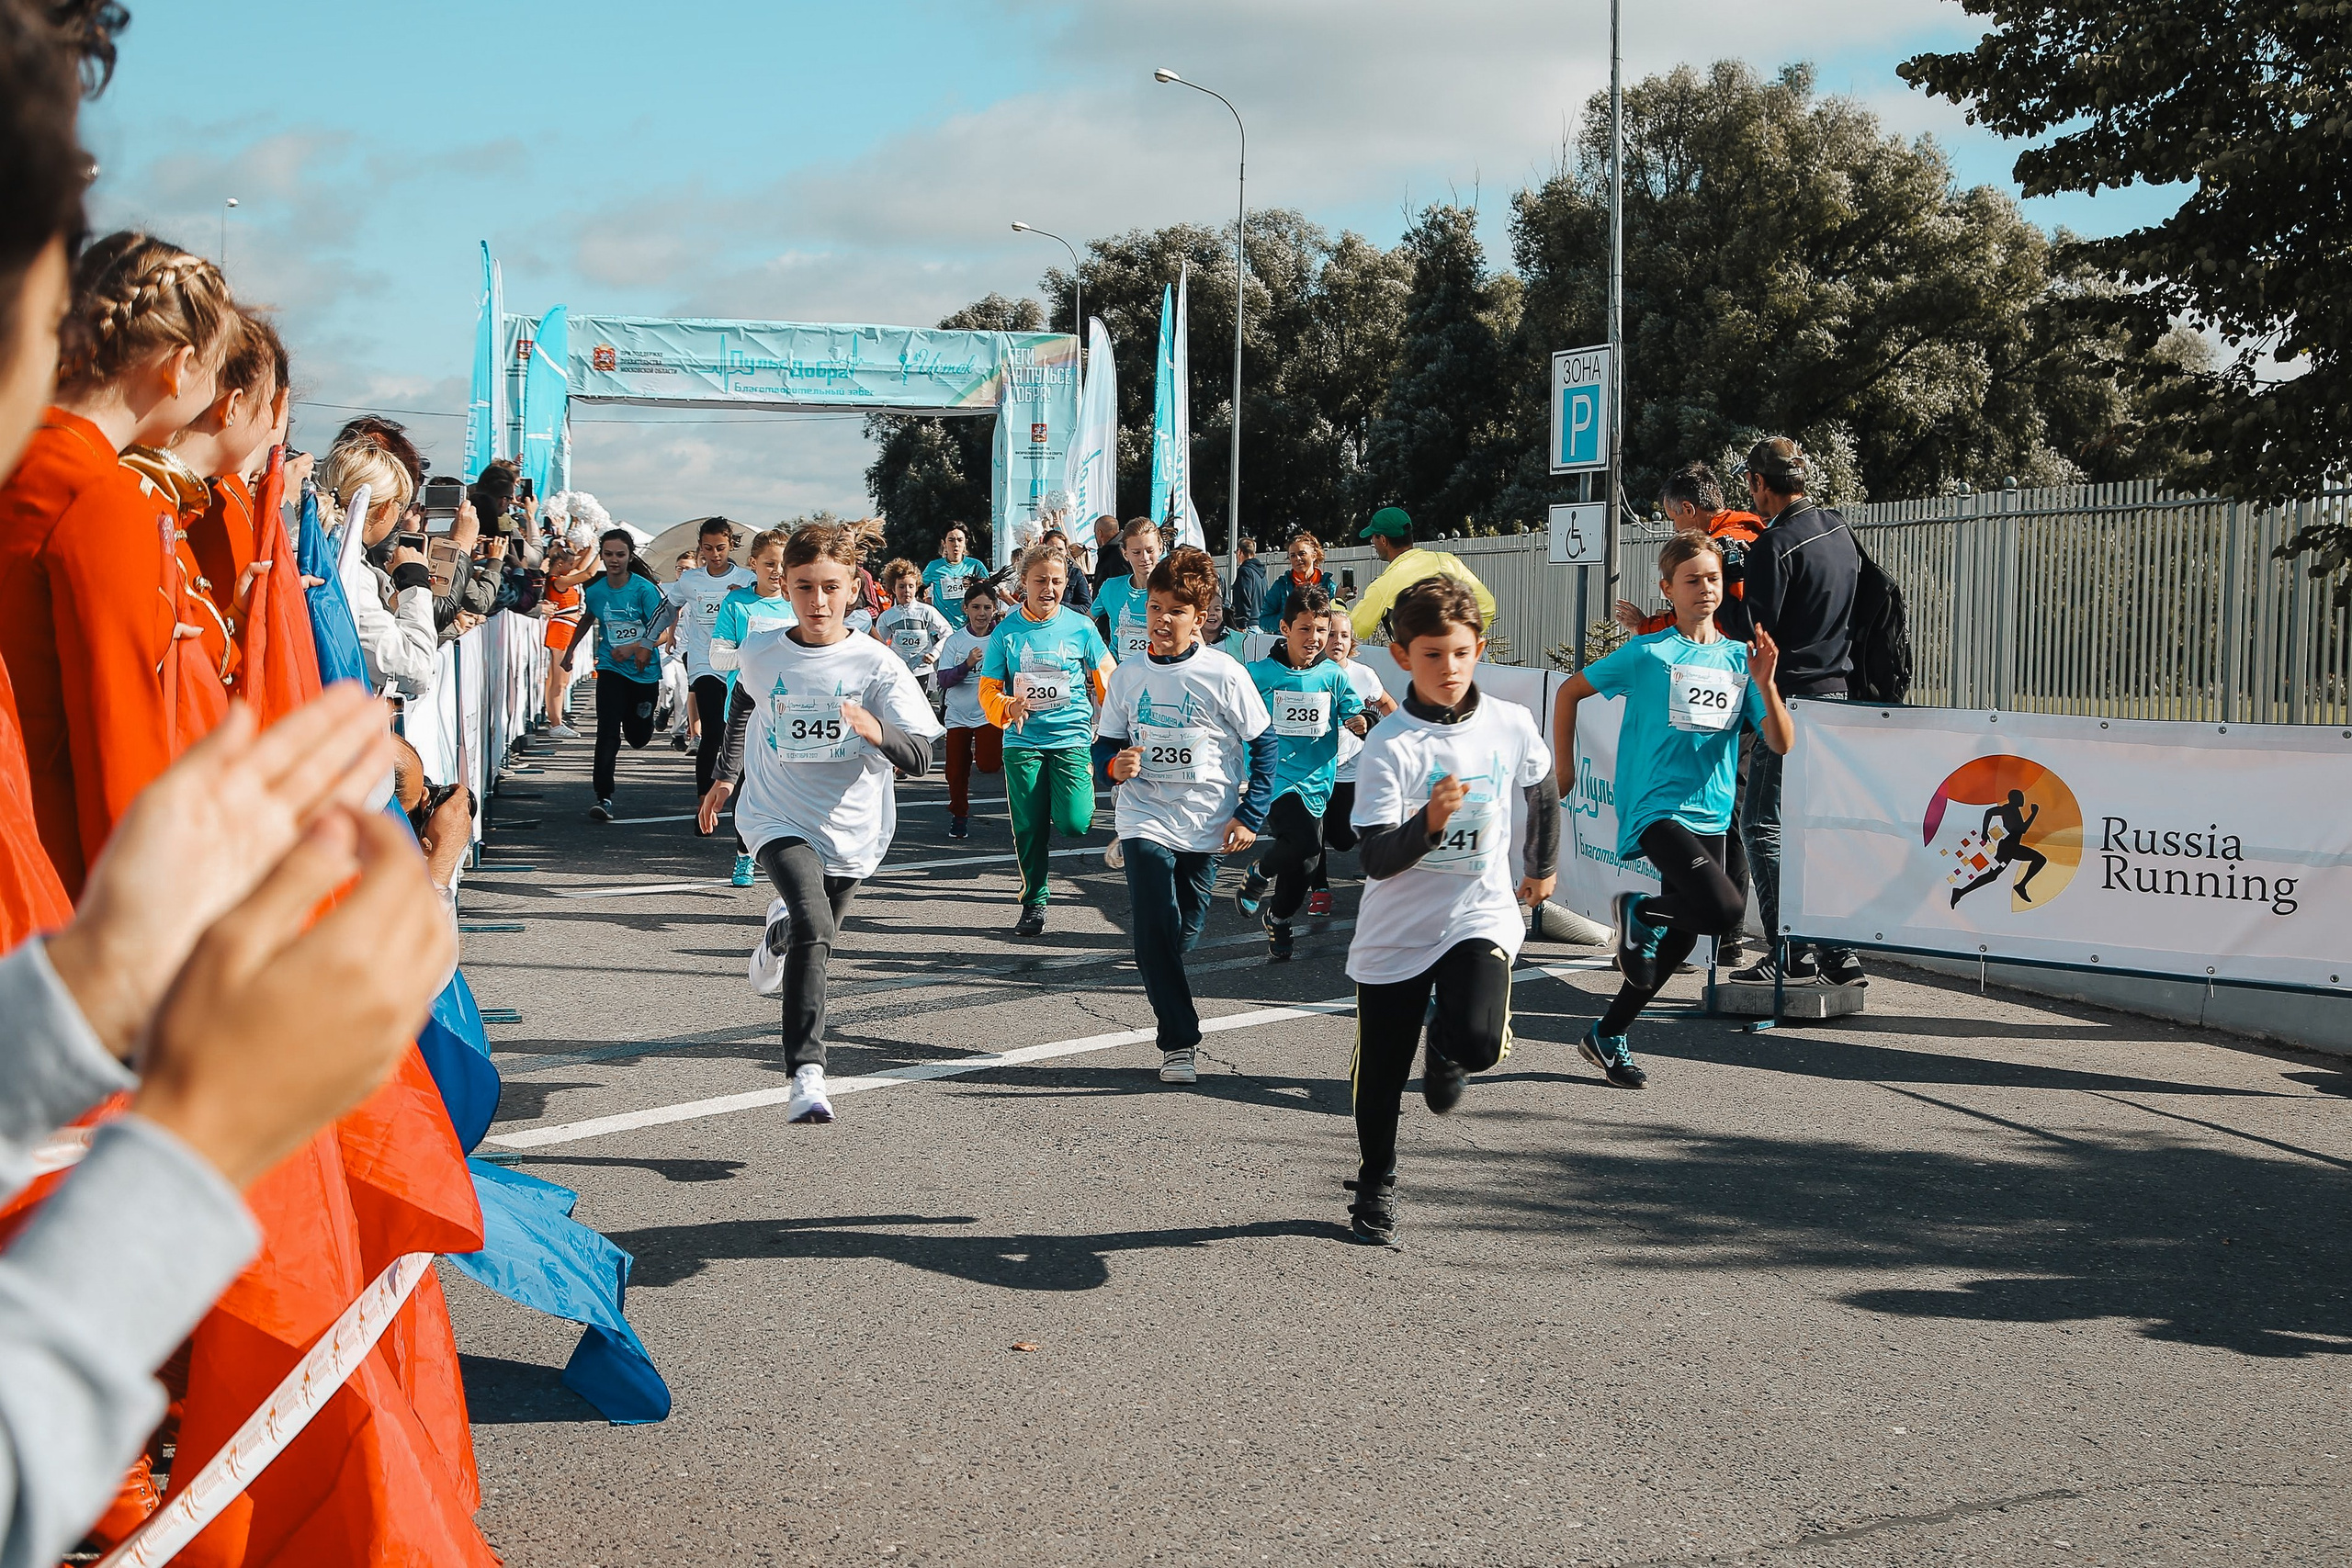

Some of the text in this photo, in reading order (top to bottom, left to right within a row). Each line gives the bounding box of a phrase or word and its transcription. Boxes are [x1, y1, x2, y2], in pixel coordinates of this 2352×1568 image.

[1008, 348, 1035, 366] БЕГИ
[730, 350, 850, 386] Пульс Добра
[1025, 367, 1071, 385] ПУЛЬСЕ
[1563, 355, 1601, 385] ЗОНА
[735, 382, 845, 396] Благотворительный
[1009, 386, 1052, 403] ДОБРА!
[1570, 394, 1592, 457] P
[706, 603, 720, 614] 24
[616, 628, 638, 639] 229
[902, 637, 920, 646] 204
[1129, 638, 1152, 651] 23
[1026, 686, 1057, 699] 230
[1688, 687, 1727, 710] 226
[1285, 707, 1319, 722] 238
[791, 719, 842, 739] 345
[1151, 746, 1193, 765] 236
[1579, 757, 1615, 818] Пуль
[2099, 816, 2245, 862] Russia
[2101, 854, 2300, 916] Running
